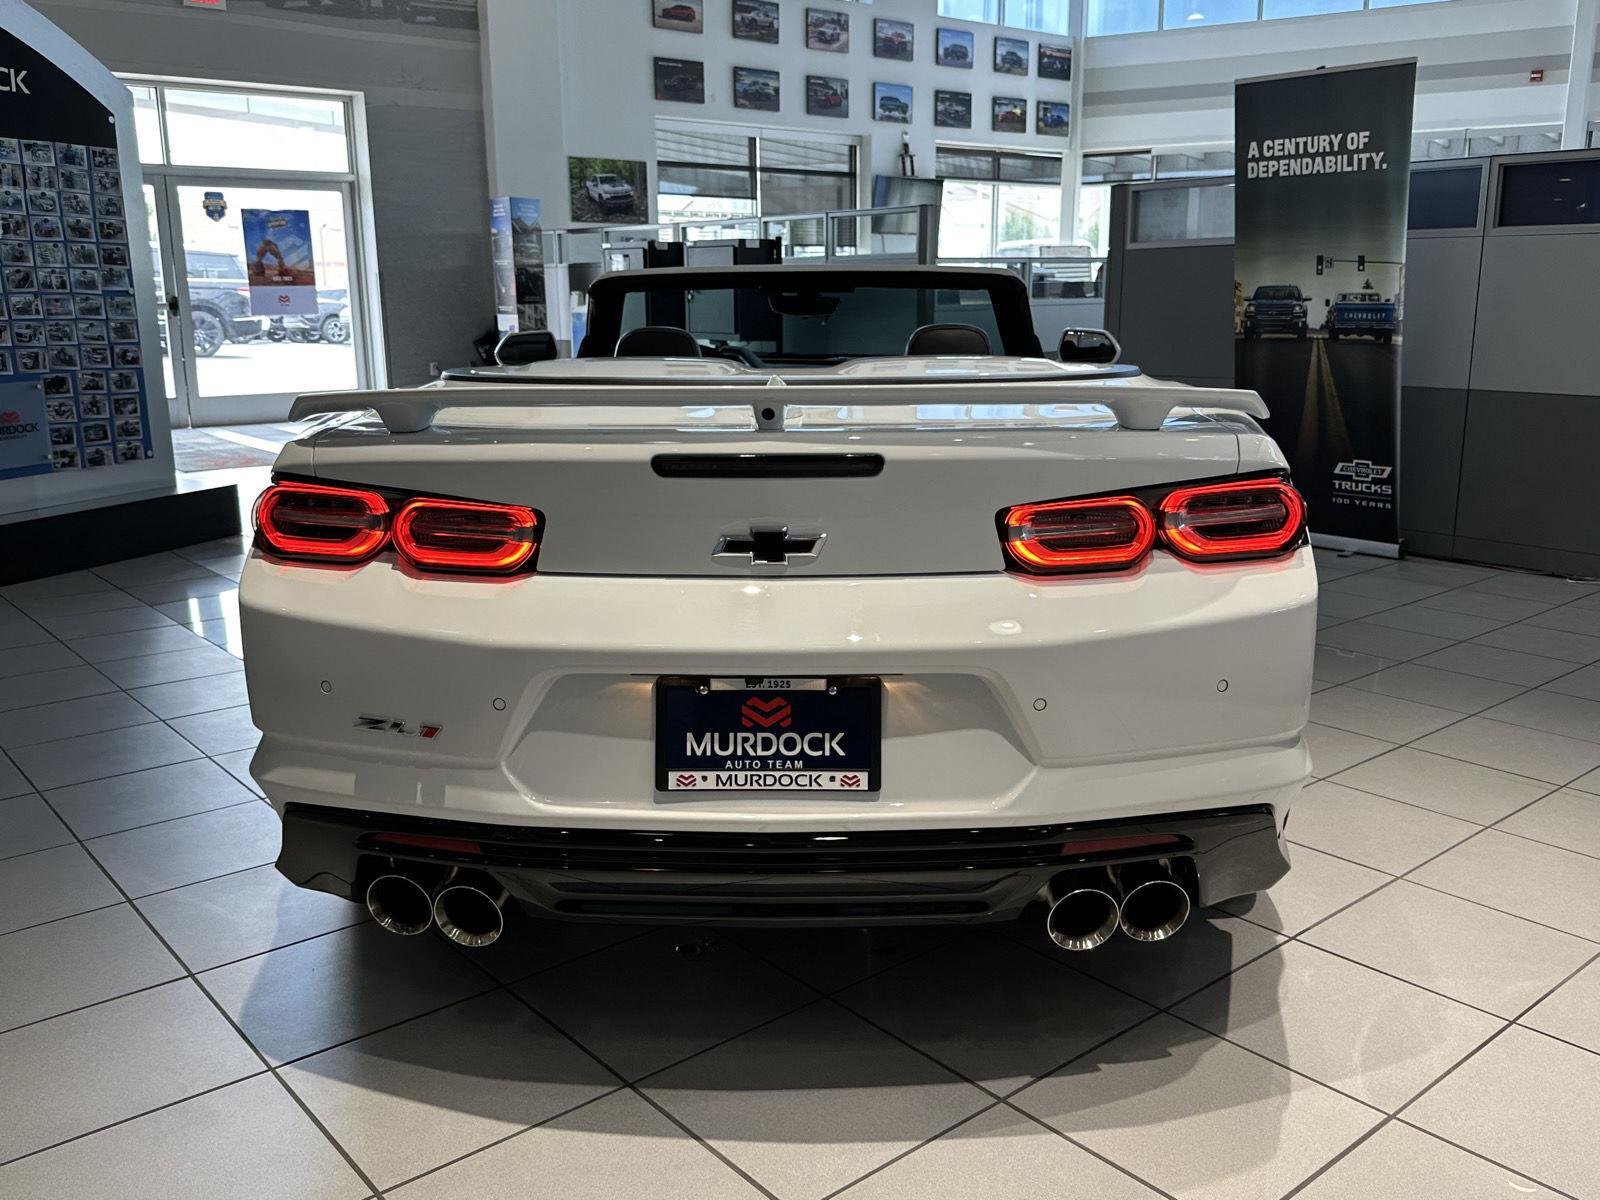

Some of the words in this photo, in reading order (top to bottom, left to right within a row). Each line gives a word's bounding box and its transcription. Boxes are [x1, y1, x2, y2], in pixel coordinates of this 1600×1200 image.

[1247, 141, 1260, 159] A
[1262, 133, 1343, 158] CENTURY
[1346, 131, 1370, 150] OF
[1247, 151, 1388, 179] DEPENDABILITY.
[1344, 312, 1386, 320] CHEVROLET
[0, 423, 39, 435] RDOCK
[1332, 480, 1392, 495] TRUCKS
[1332, 497, 1350, 505] 100
[1354, 499, 1392, 509] YEARS
[767, 679, 791, 689] 1925
[686, 732, 846, 757] MURDOCK
[725, 760, 761, 770] AUTO
[768, 760, 804, 770] TEAM
[715, 773, 824, 788] MURDOCK
